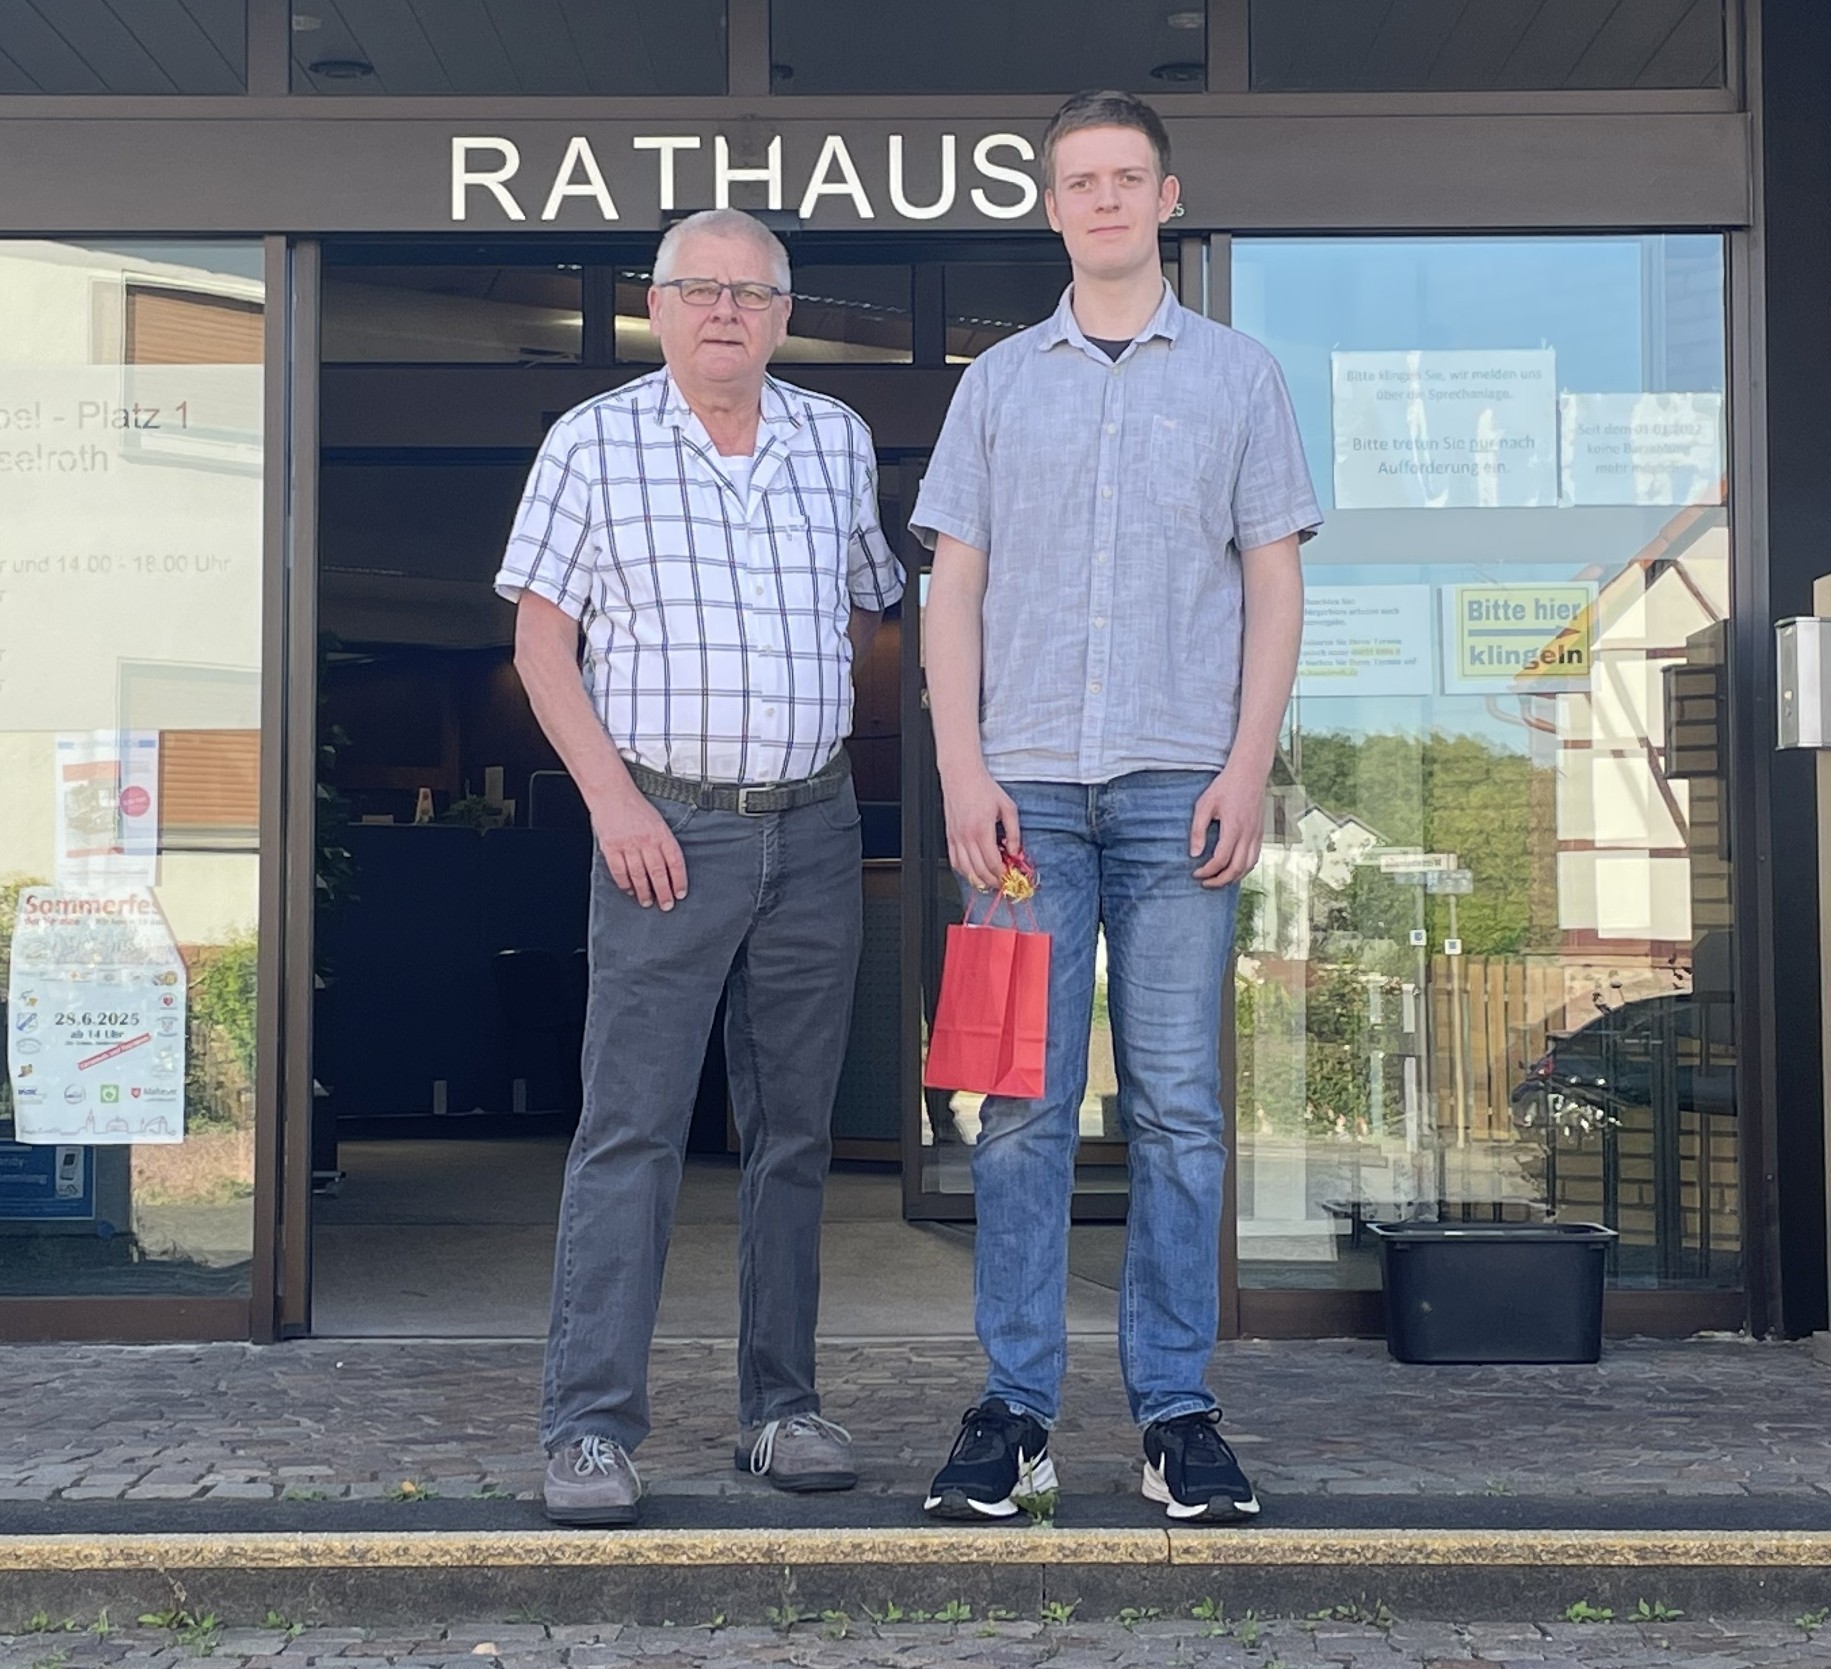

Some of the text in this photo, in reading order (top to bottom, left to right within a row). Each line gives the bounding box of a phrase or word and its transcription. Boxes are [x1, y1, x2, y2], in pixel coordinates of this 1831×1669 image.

[450, 134, 1038, 221] RATHAUS
[1346, 369, 1376, 382] Bitte
[1471, 368, 1518, 380] melden
[1520, 369, 1543, 380] uns
[78, 401, 161, 430] Platz
[175, 401, 188, 430] 1
[1352, 437, 1389, 451] Bitte
[1443, 436, 1466, 450] Sie
[1499, 435, 1535, 449] nach
[1377, 460, 1480, 477] Aufforderung
[13, 555, 49, 574] und
[195, 555, 231, 573] Uhr
[1467, 598, 1582, 621] Bitte hier
[1469, 645, 1583, 671] klingeln
[54, 1012, 140, 1026] 28.6.2025
